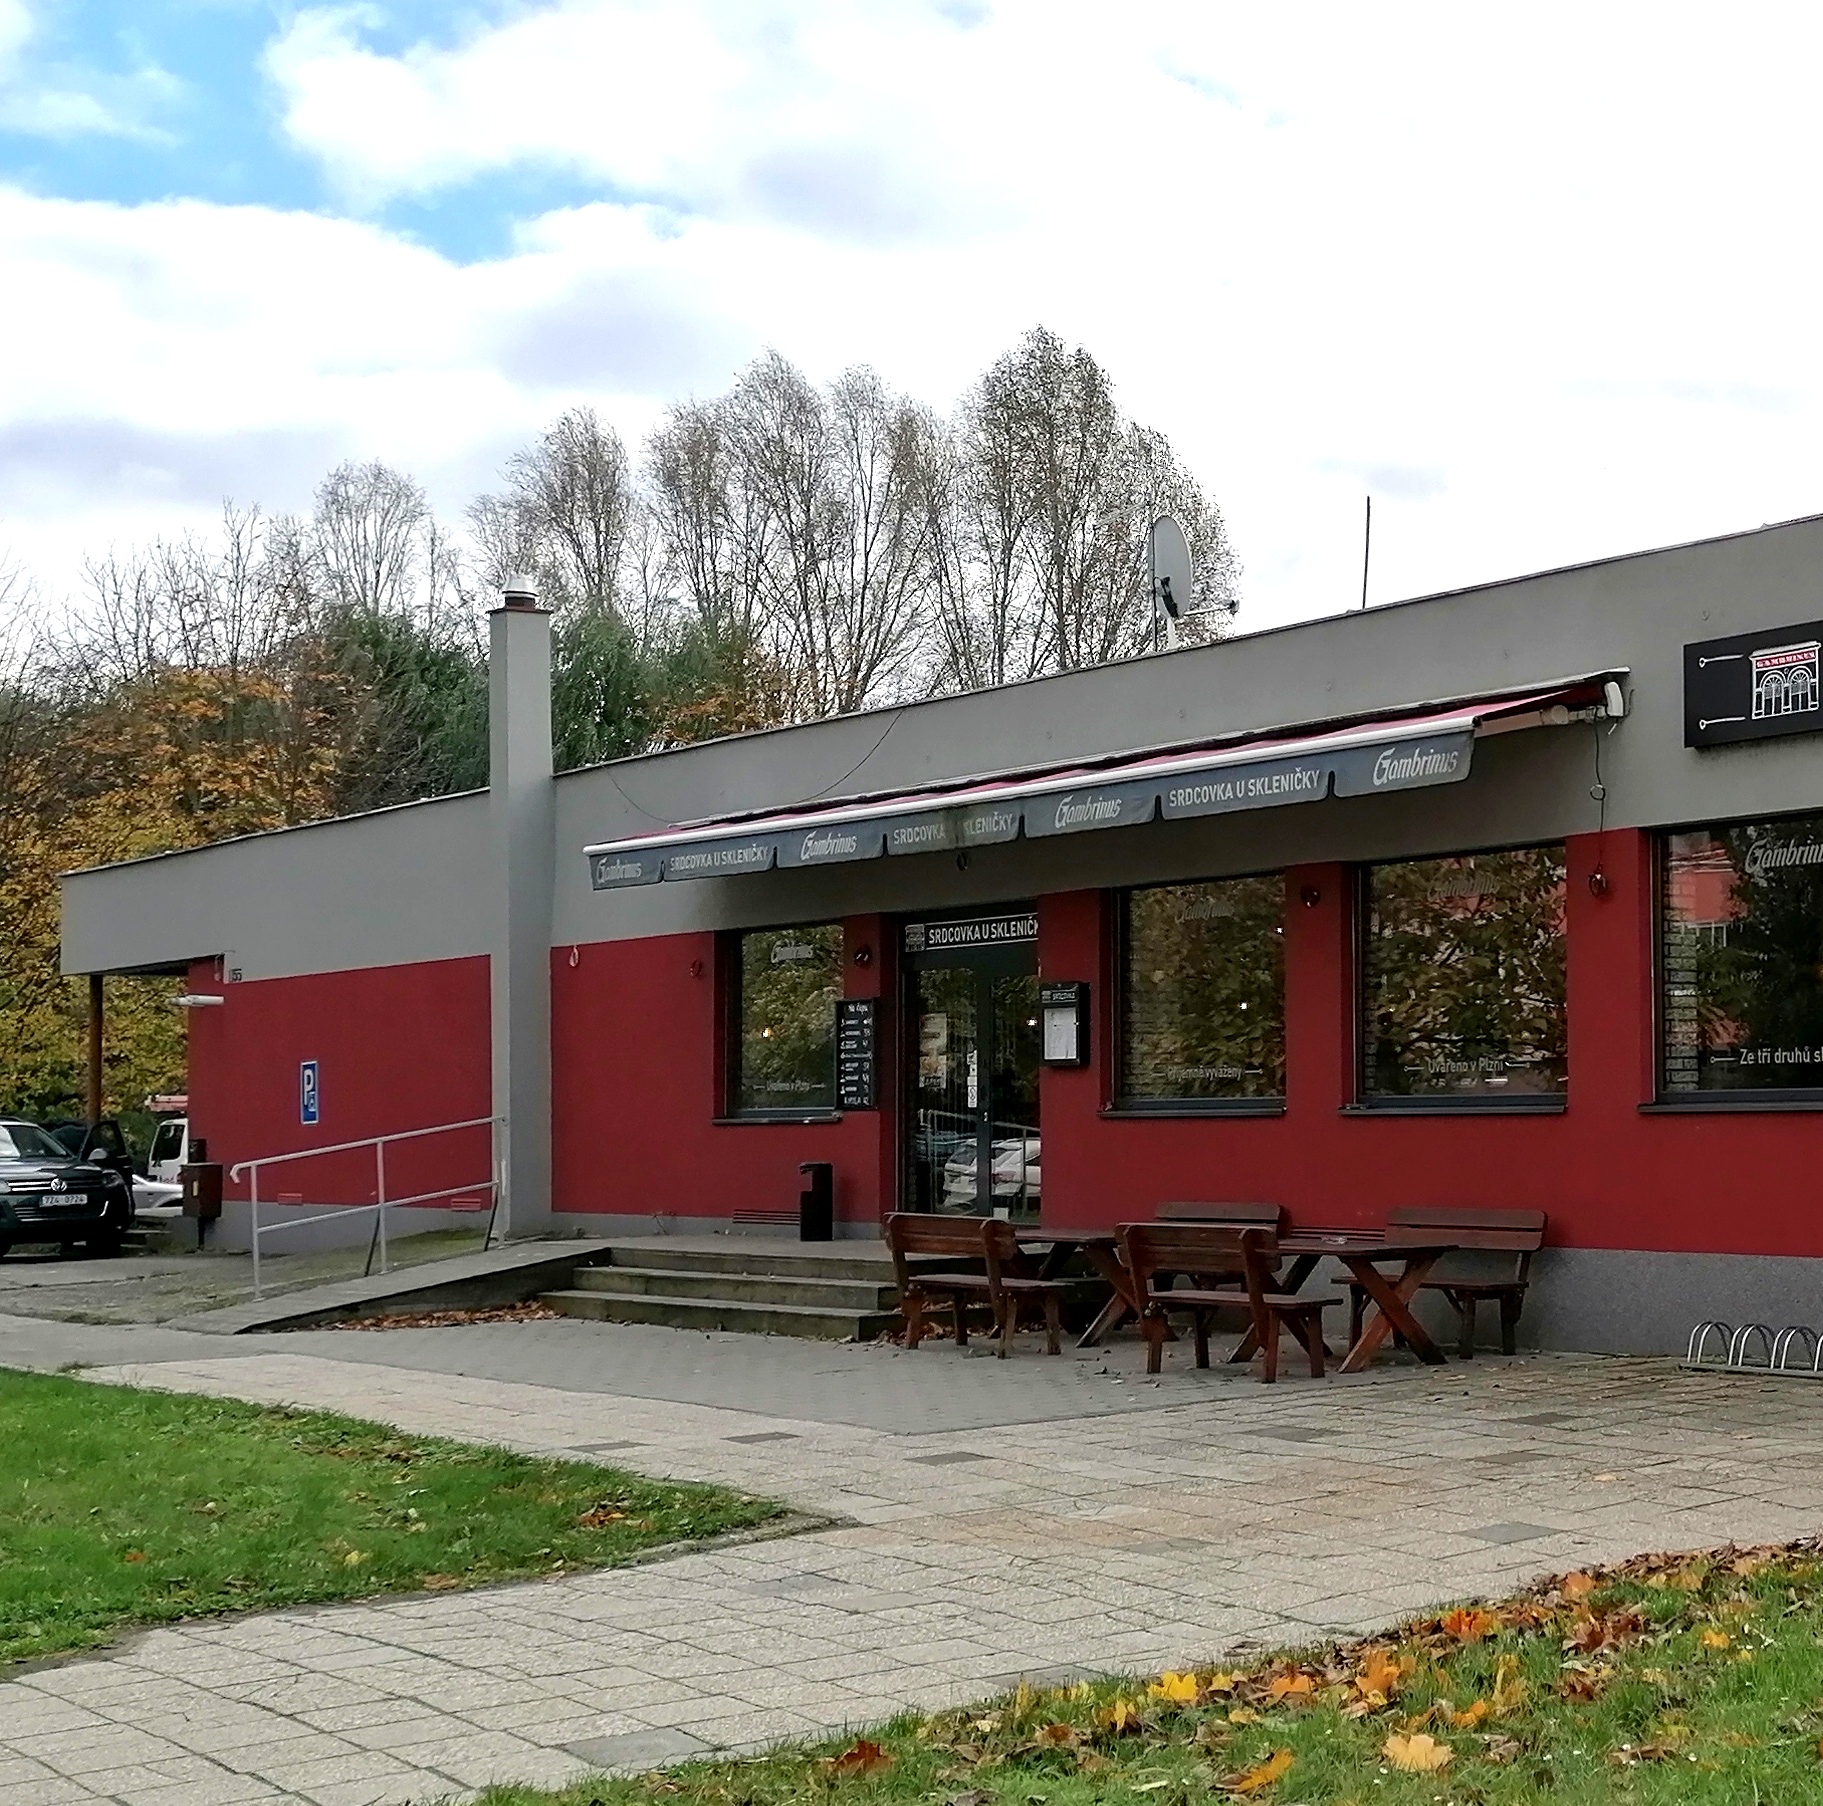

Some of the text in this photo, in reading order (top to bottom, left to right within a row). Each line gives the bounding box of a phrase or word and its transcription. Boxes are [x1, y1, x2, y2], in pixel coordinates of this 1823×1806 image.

[1372, 747, 1459, 786] Gambrinus
[1169, 766, 1321, 808] SRDCOVKA U SKLENIČKY
[1054, 793, 1122, 829] Gambrinus
[800, 830, 858, 861] Gambrinus
[893, 822, 947, 845] SRDCOVKA
[669, 843, 769, 871] SRDCOVKA U SKLENIČKY
[928, 924, 982, 945] SRDCOVKA
[982, 923, 990, 939] U
[1740, 1048, 1755, 1065] Ze
[1758, 1047, 1772, 1064] tří
[1774, 1045, 1811, 1064] druhů
[303, 1069, 314, 1106] P
